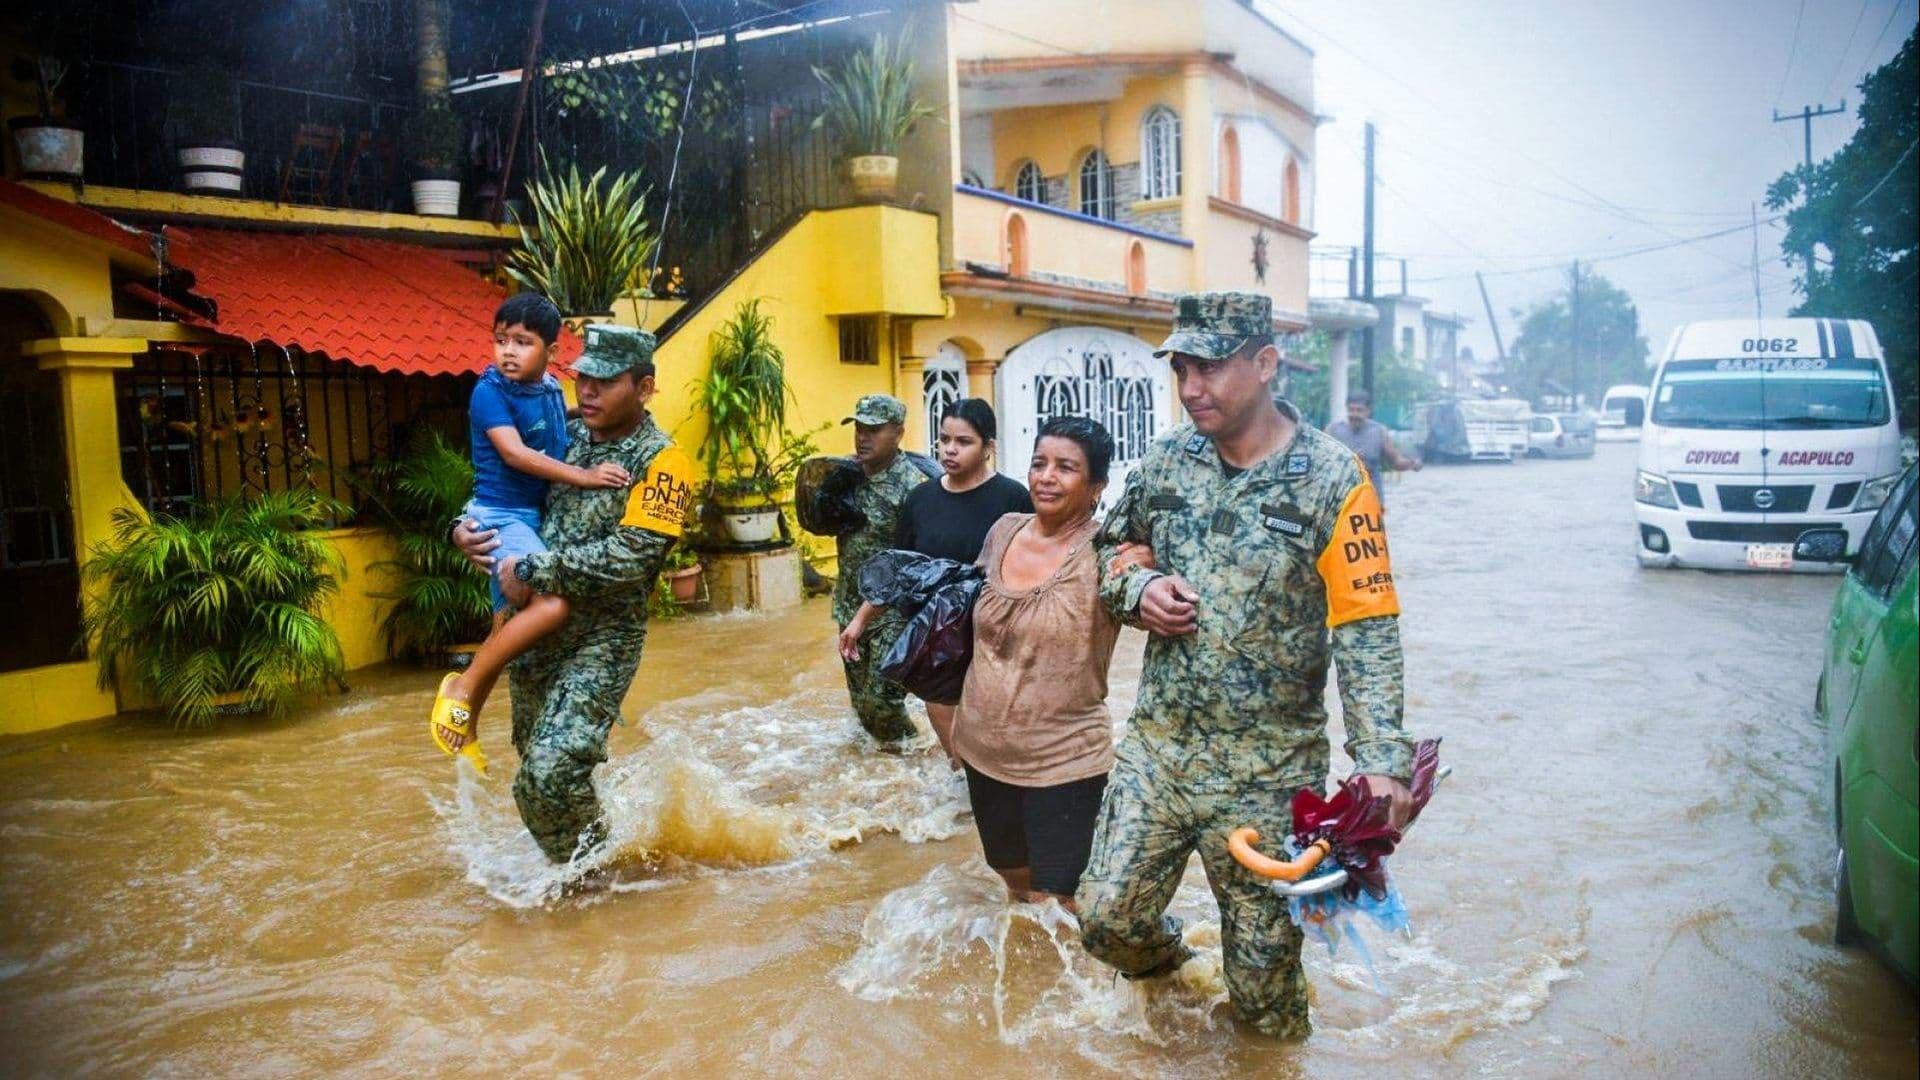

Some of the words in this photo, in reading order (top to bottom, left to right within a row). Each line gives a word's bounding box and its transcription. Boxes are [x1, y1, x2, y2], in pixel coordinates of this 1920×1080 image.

[1742, 338, 1798, 353] 0062
[1685, 450, 1741, 465] COYUCA
[1778, 451, 1854, 466] ACAPULCO
